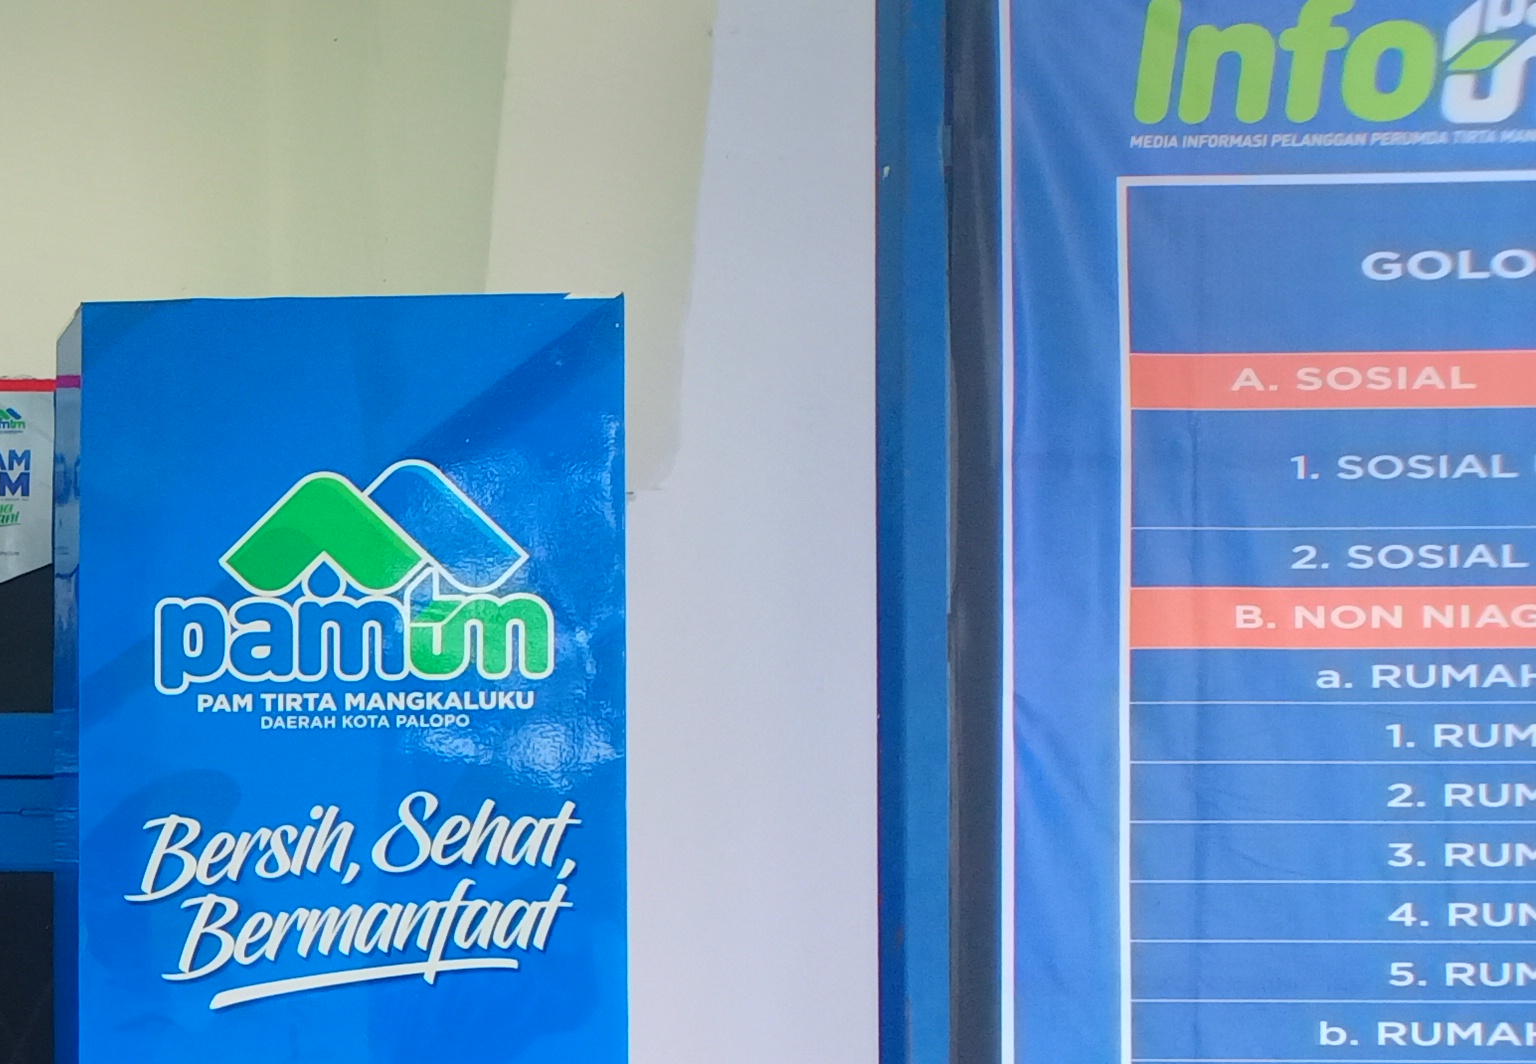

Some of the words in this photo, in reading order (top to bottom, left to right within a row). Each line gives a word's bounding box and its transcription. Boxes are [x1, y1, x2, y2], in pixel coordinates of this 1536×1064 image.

[1134, 0, 1437, 124] Info
[1129, 135, 1178, 148] MEDIA
[1182, 133, 1267, 148] INFORMASI
[1270, 132, 1365, 147] PELANGGAN
[1230, 367, 1279, 392] A.
[1296, 366, 1477, 391] SOSIAL
[1290, 455, 1319, 480] 1.
[1336, 454, 1519, 479] SOSIAL
[1291, 545, 1330, 570] 2.
[1347, 544, 1528, 569] SOSIAL
[1235, 605, 1276, 629] B.
[1294, 605, 1402, 629] NON
[1316, 668, 1352, 689] a.
[197, 693, 252, 712] PAM
[261, 692, 331, 712] TIRTA
[345, 691, 535, 711] MANGKALUKU
[261, 714, 336, 729] DAERAH
[342, 714, 389, 728] KOTA
[396, 714, 470, 728] PALOPO
[124, 804, 359, 902] Bersih,
[372, 791, 583, 879] Sehat,
[161, 878, 574, 984] Bermanfaat
[1319, 1022, 1359, 1046] b.
